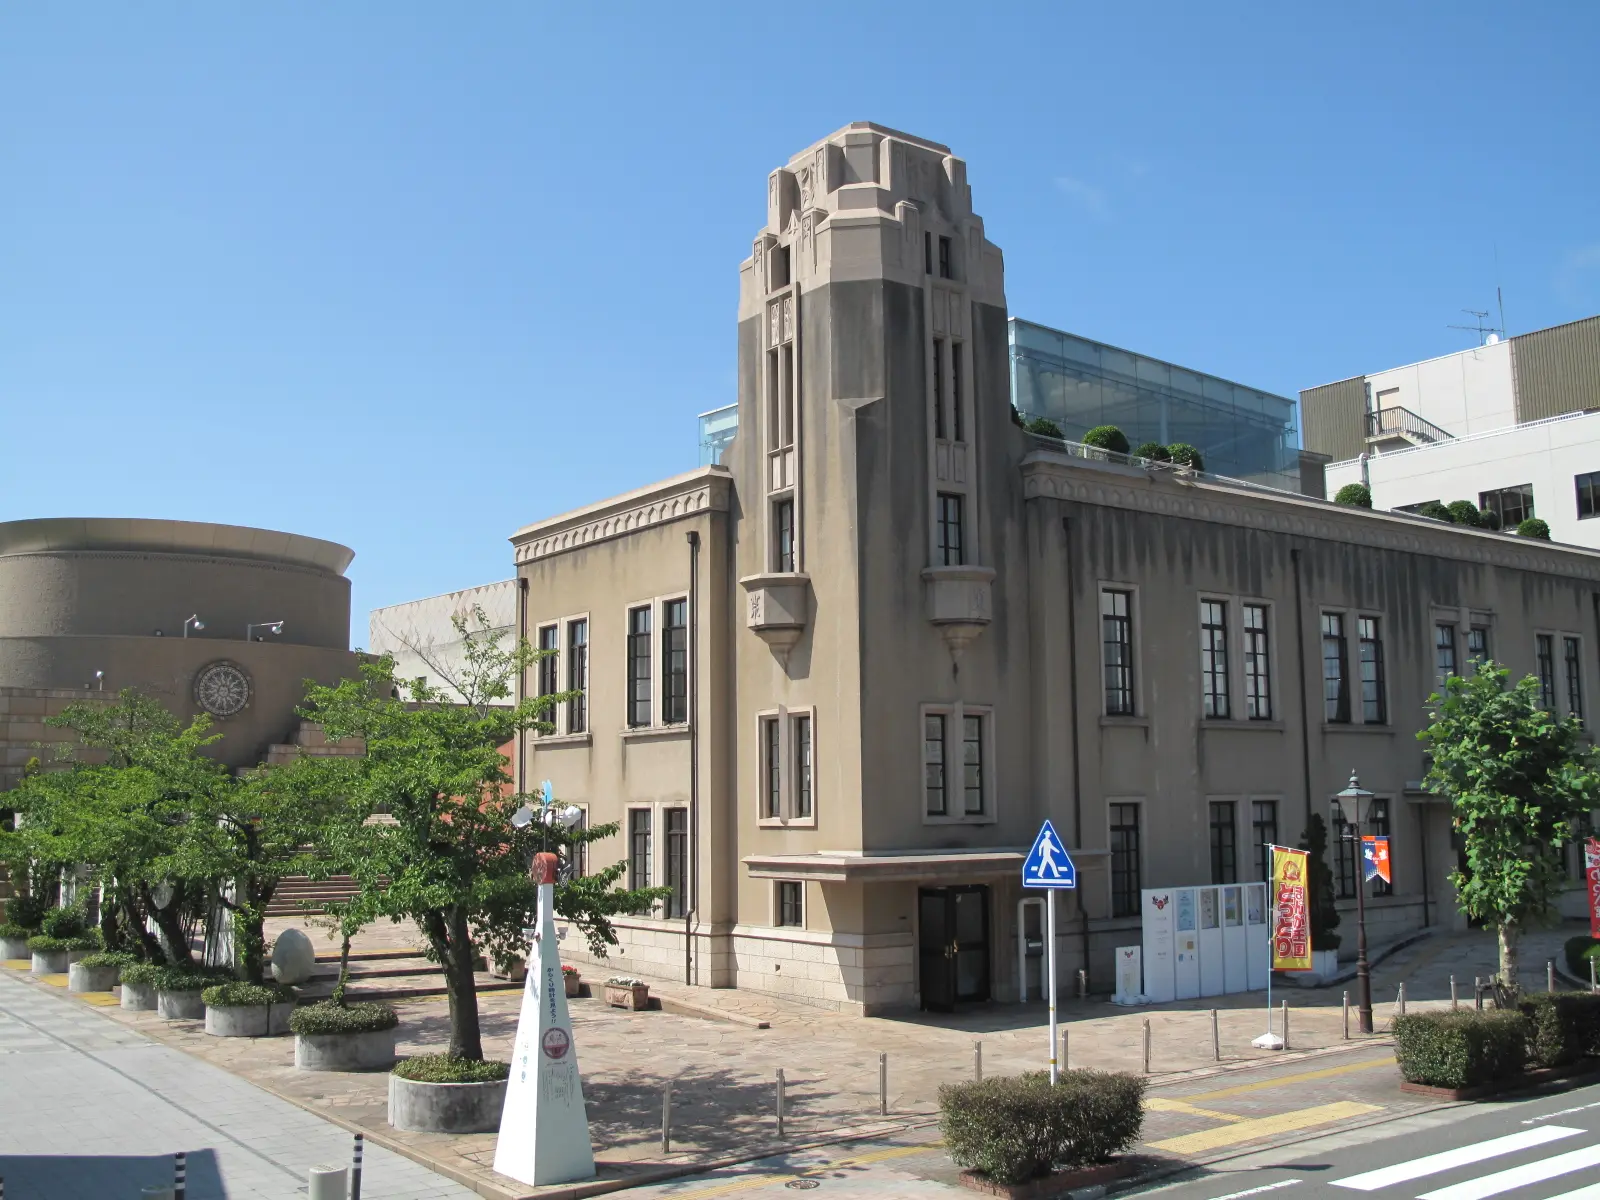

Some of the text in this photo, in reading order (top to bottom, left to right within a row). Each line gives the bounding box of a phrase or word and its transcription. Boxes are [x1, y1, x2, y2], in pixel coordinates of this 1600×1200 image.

[1275, 882, 1295, 958] とっとり
[1292, 885, 1307, 958] まんが王国
